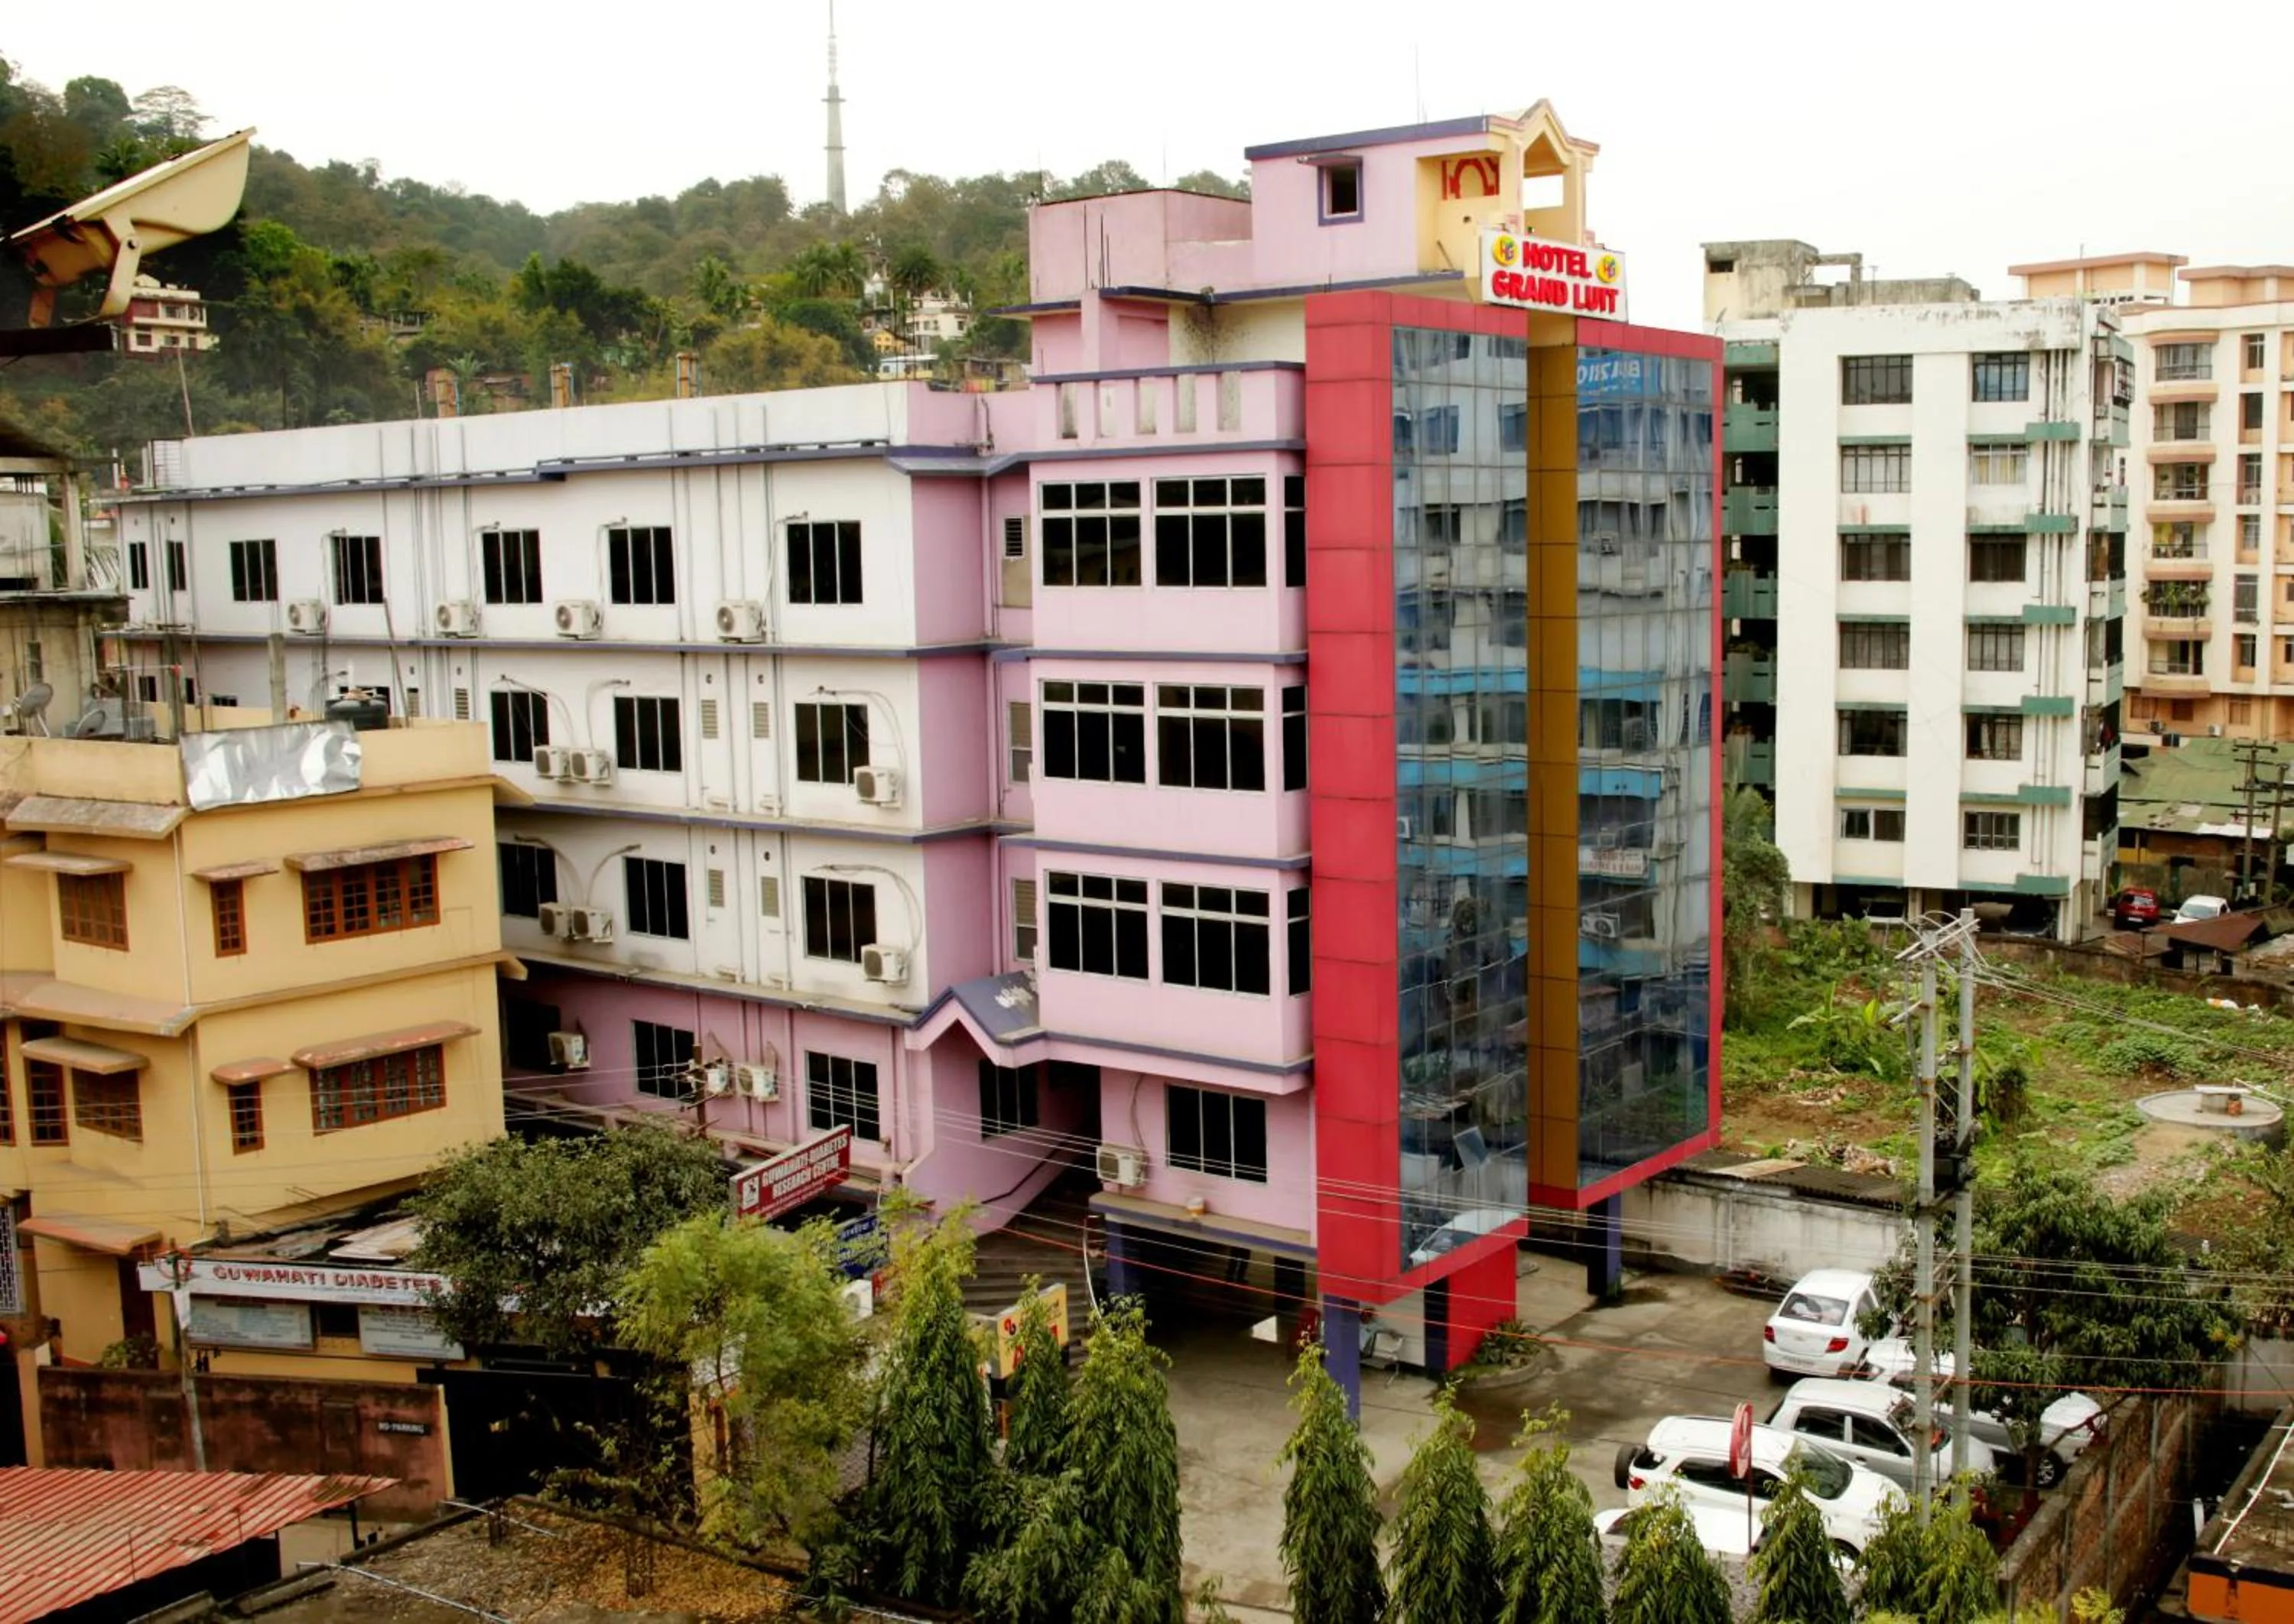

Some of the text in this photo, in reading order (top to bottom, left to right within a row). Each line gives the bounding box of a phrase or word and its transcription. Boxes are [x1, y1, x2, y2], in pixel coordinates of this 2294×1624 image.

[1522, 241, 1591, 278] HOTEL
[1492, 270, 1619, 313] GRAND LUIT
[213, 1265, 326, 1285] GUWAHATI
